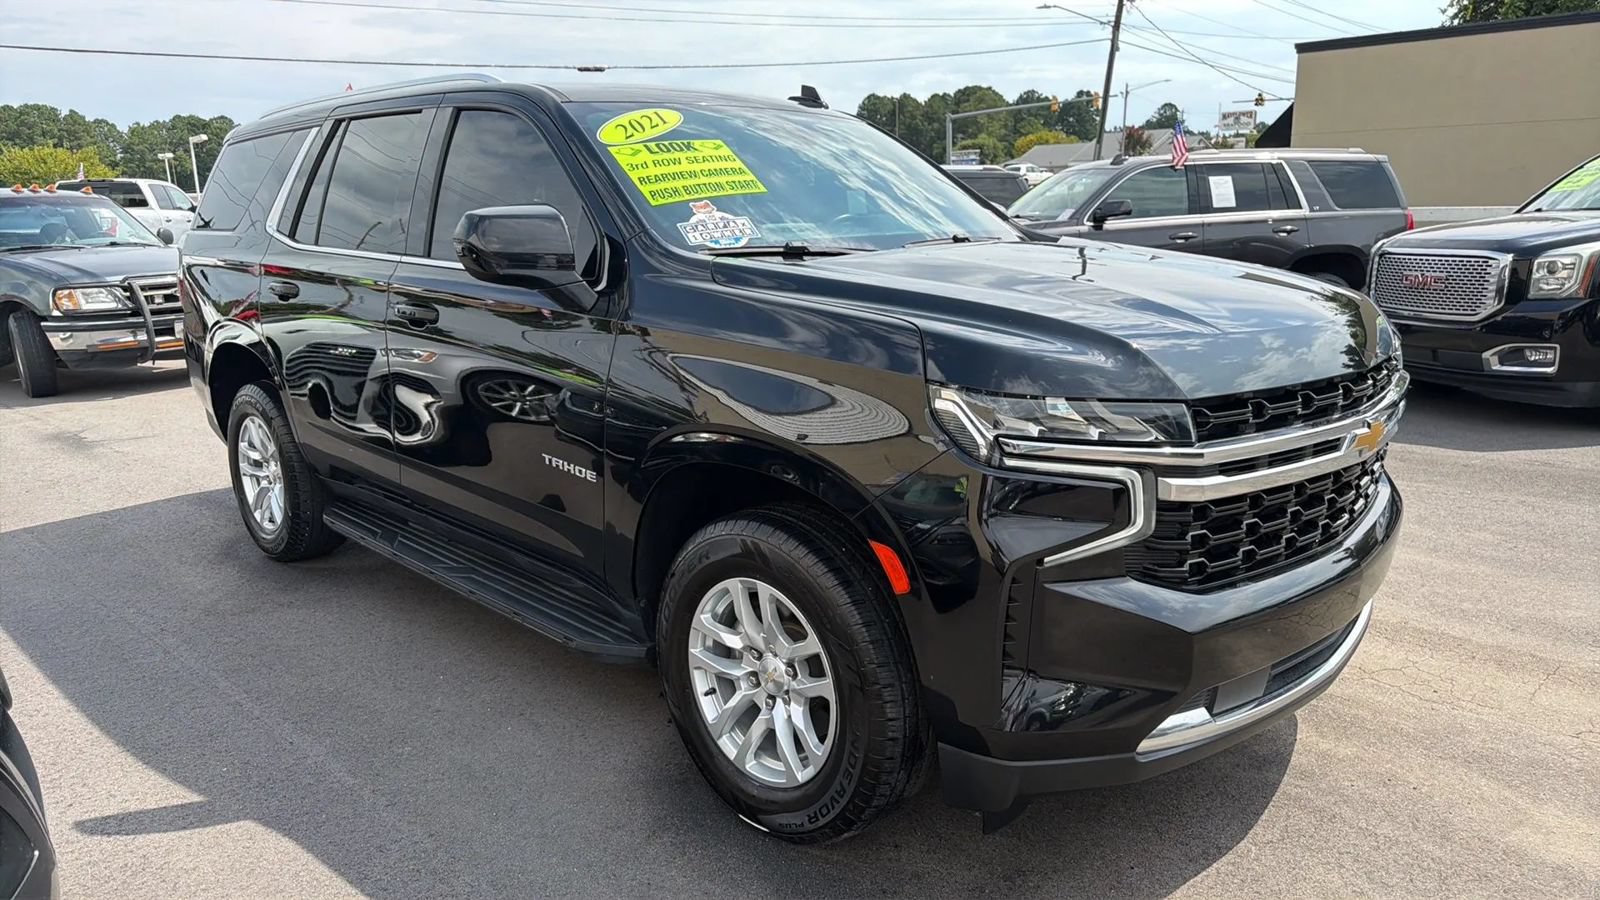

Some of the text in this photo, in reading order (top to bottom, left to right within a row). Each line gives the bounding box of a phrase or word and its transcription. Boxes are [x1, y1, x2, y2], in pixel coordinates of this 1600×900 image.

[615, 111, 670, 140] 2021
[643, 141, 698, 155] LOOK
[626, 154, 737, 172] 3rd ROW SEATING
[637, 167, 747, 186] REARVIEW CAMERA
[649, 179, 759, 201] PUSH BUTTON START
[684, 220, 748, 234] CARFAX
[700, 228, 754, 241] OWNER
[1402, 272, 1446, 289] GMC
[541, 453, 597, 483] TAHOE
[779, 822, 805, 830] PLUS
